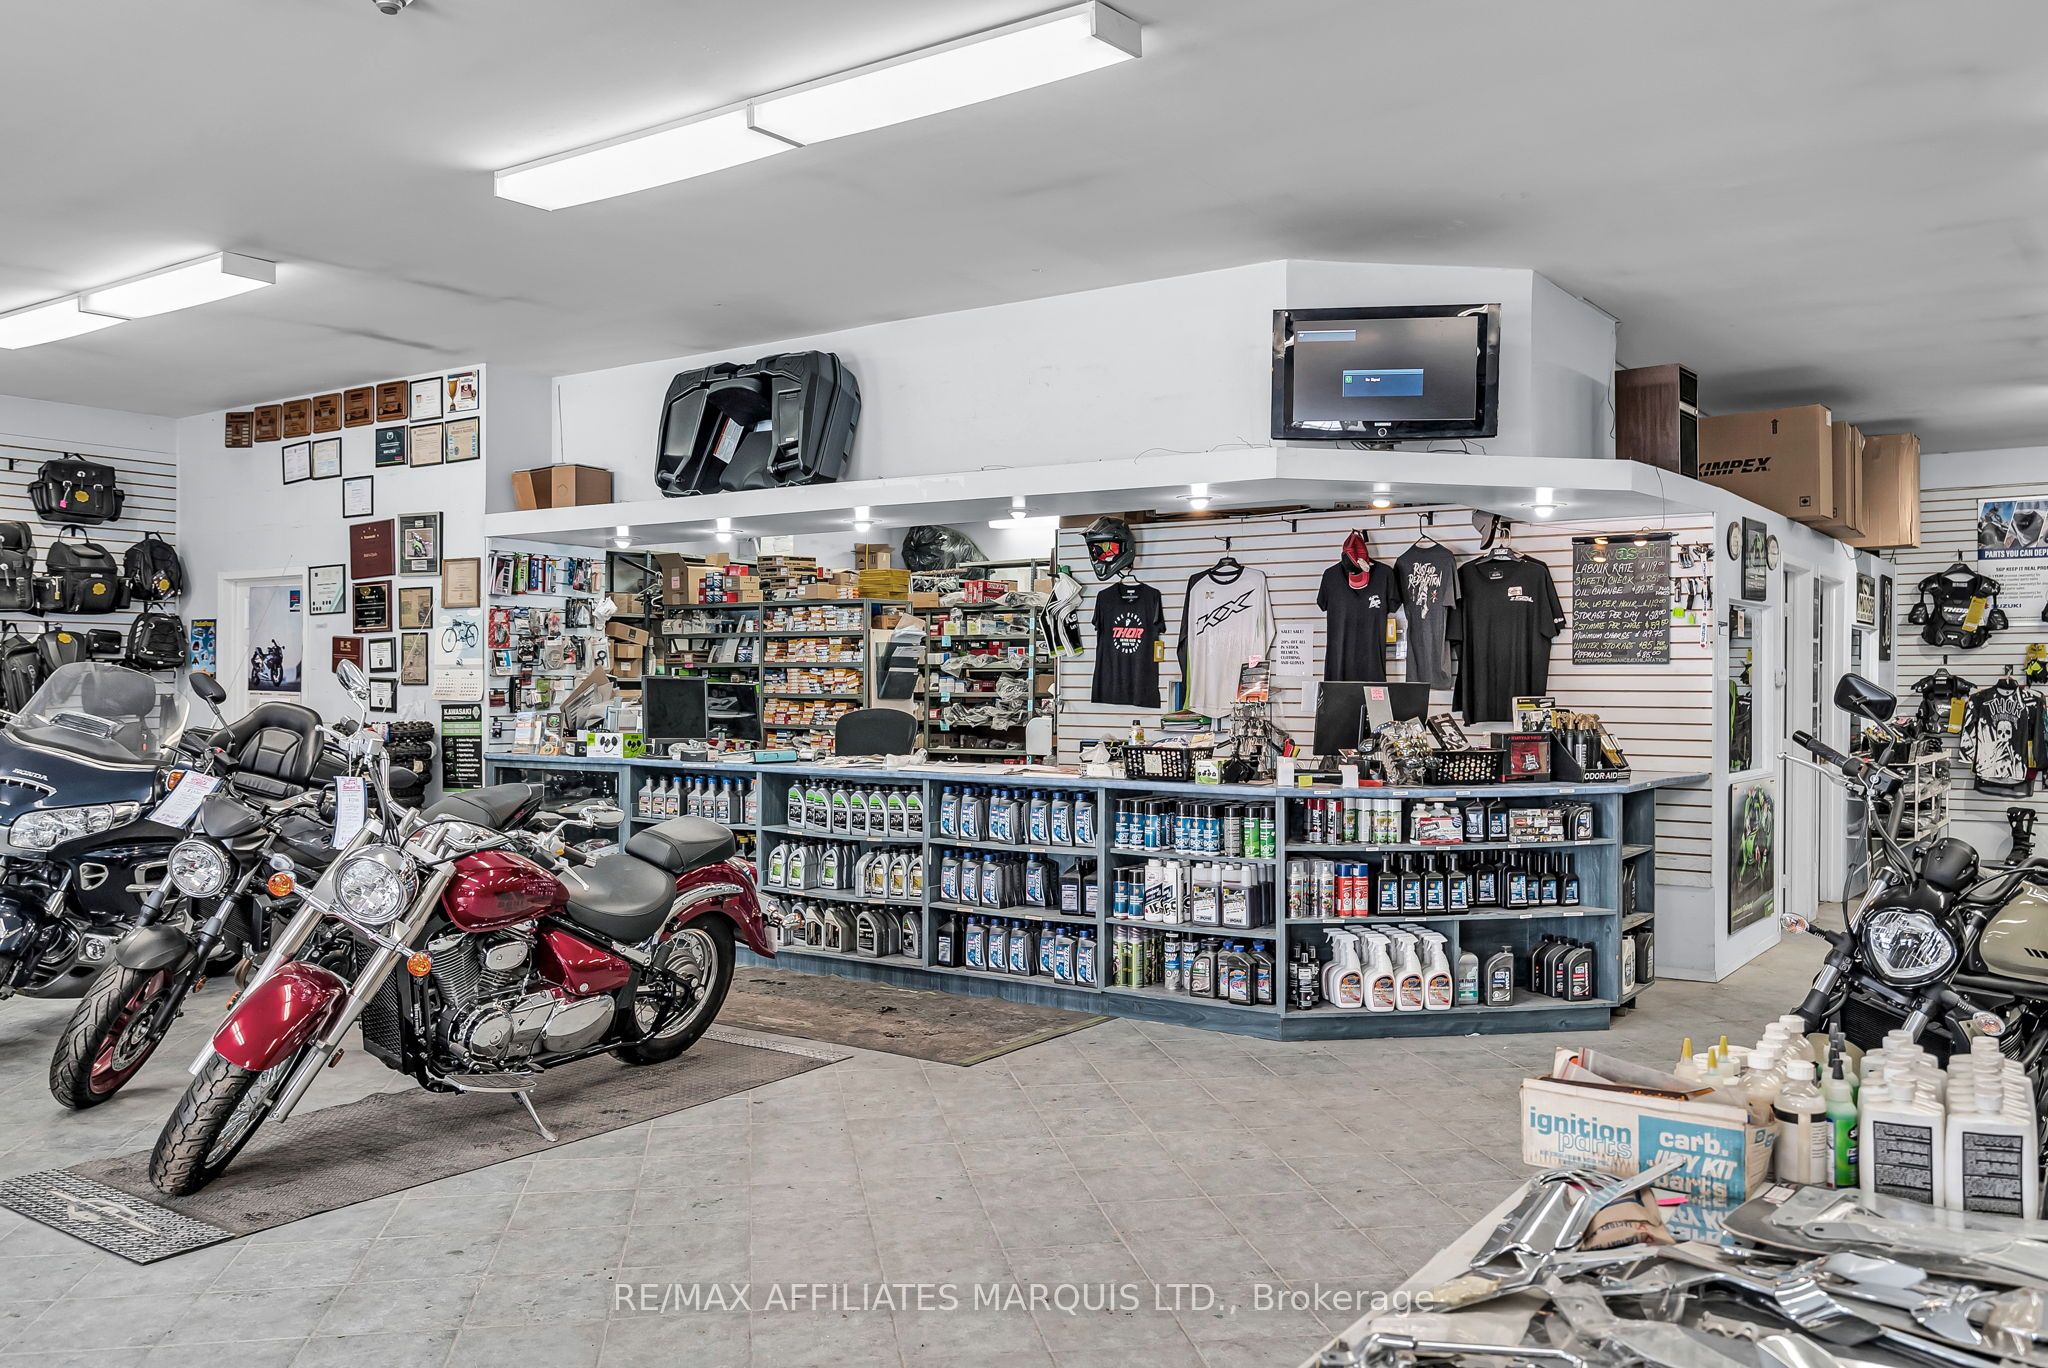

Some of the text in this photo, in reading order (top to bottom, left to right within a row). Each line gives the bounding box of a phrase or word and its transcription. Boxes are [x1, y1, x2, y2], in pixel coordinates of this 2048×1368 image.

[1984, 550, 2005, 558] PARTS
[2006, 550, 2018, 558] YOU
[2020, 549, 2032, 557] CAN
[1575, 563, 1610, 576] LABOUR
[1612, 562, 1634, 576] RATE
[1608, 576, 1635, 587] CHECK
[1592, 585, 1623, 596] CHANGE
[1624, 611, 1640, 621] DAY
[1112, 626, 1144, 638] THOR
[1983, 698, 2025, 718] THOR
[12, 768, 48, 781] HONDA
[1530, 1106, 1632, 1145] ignition
[1558, 1130, 1632, 1159] parts
[1659, 1132, 1728, 1156] carb.
[1647, 1150, 1738, 1180] JIY KIT
